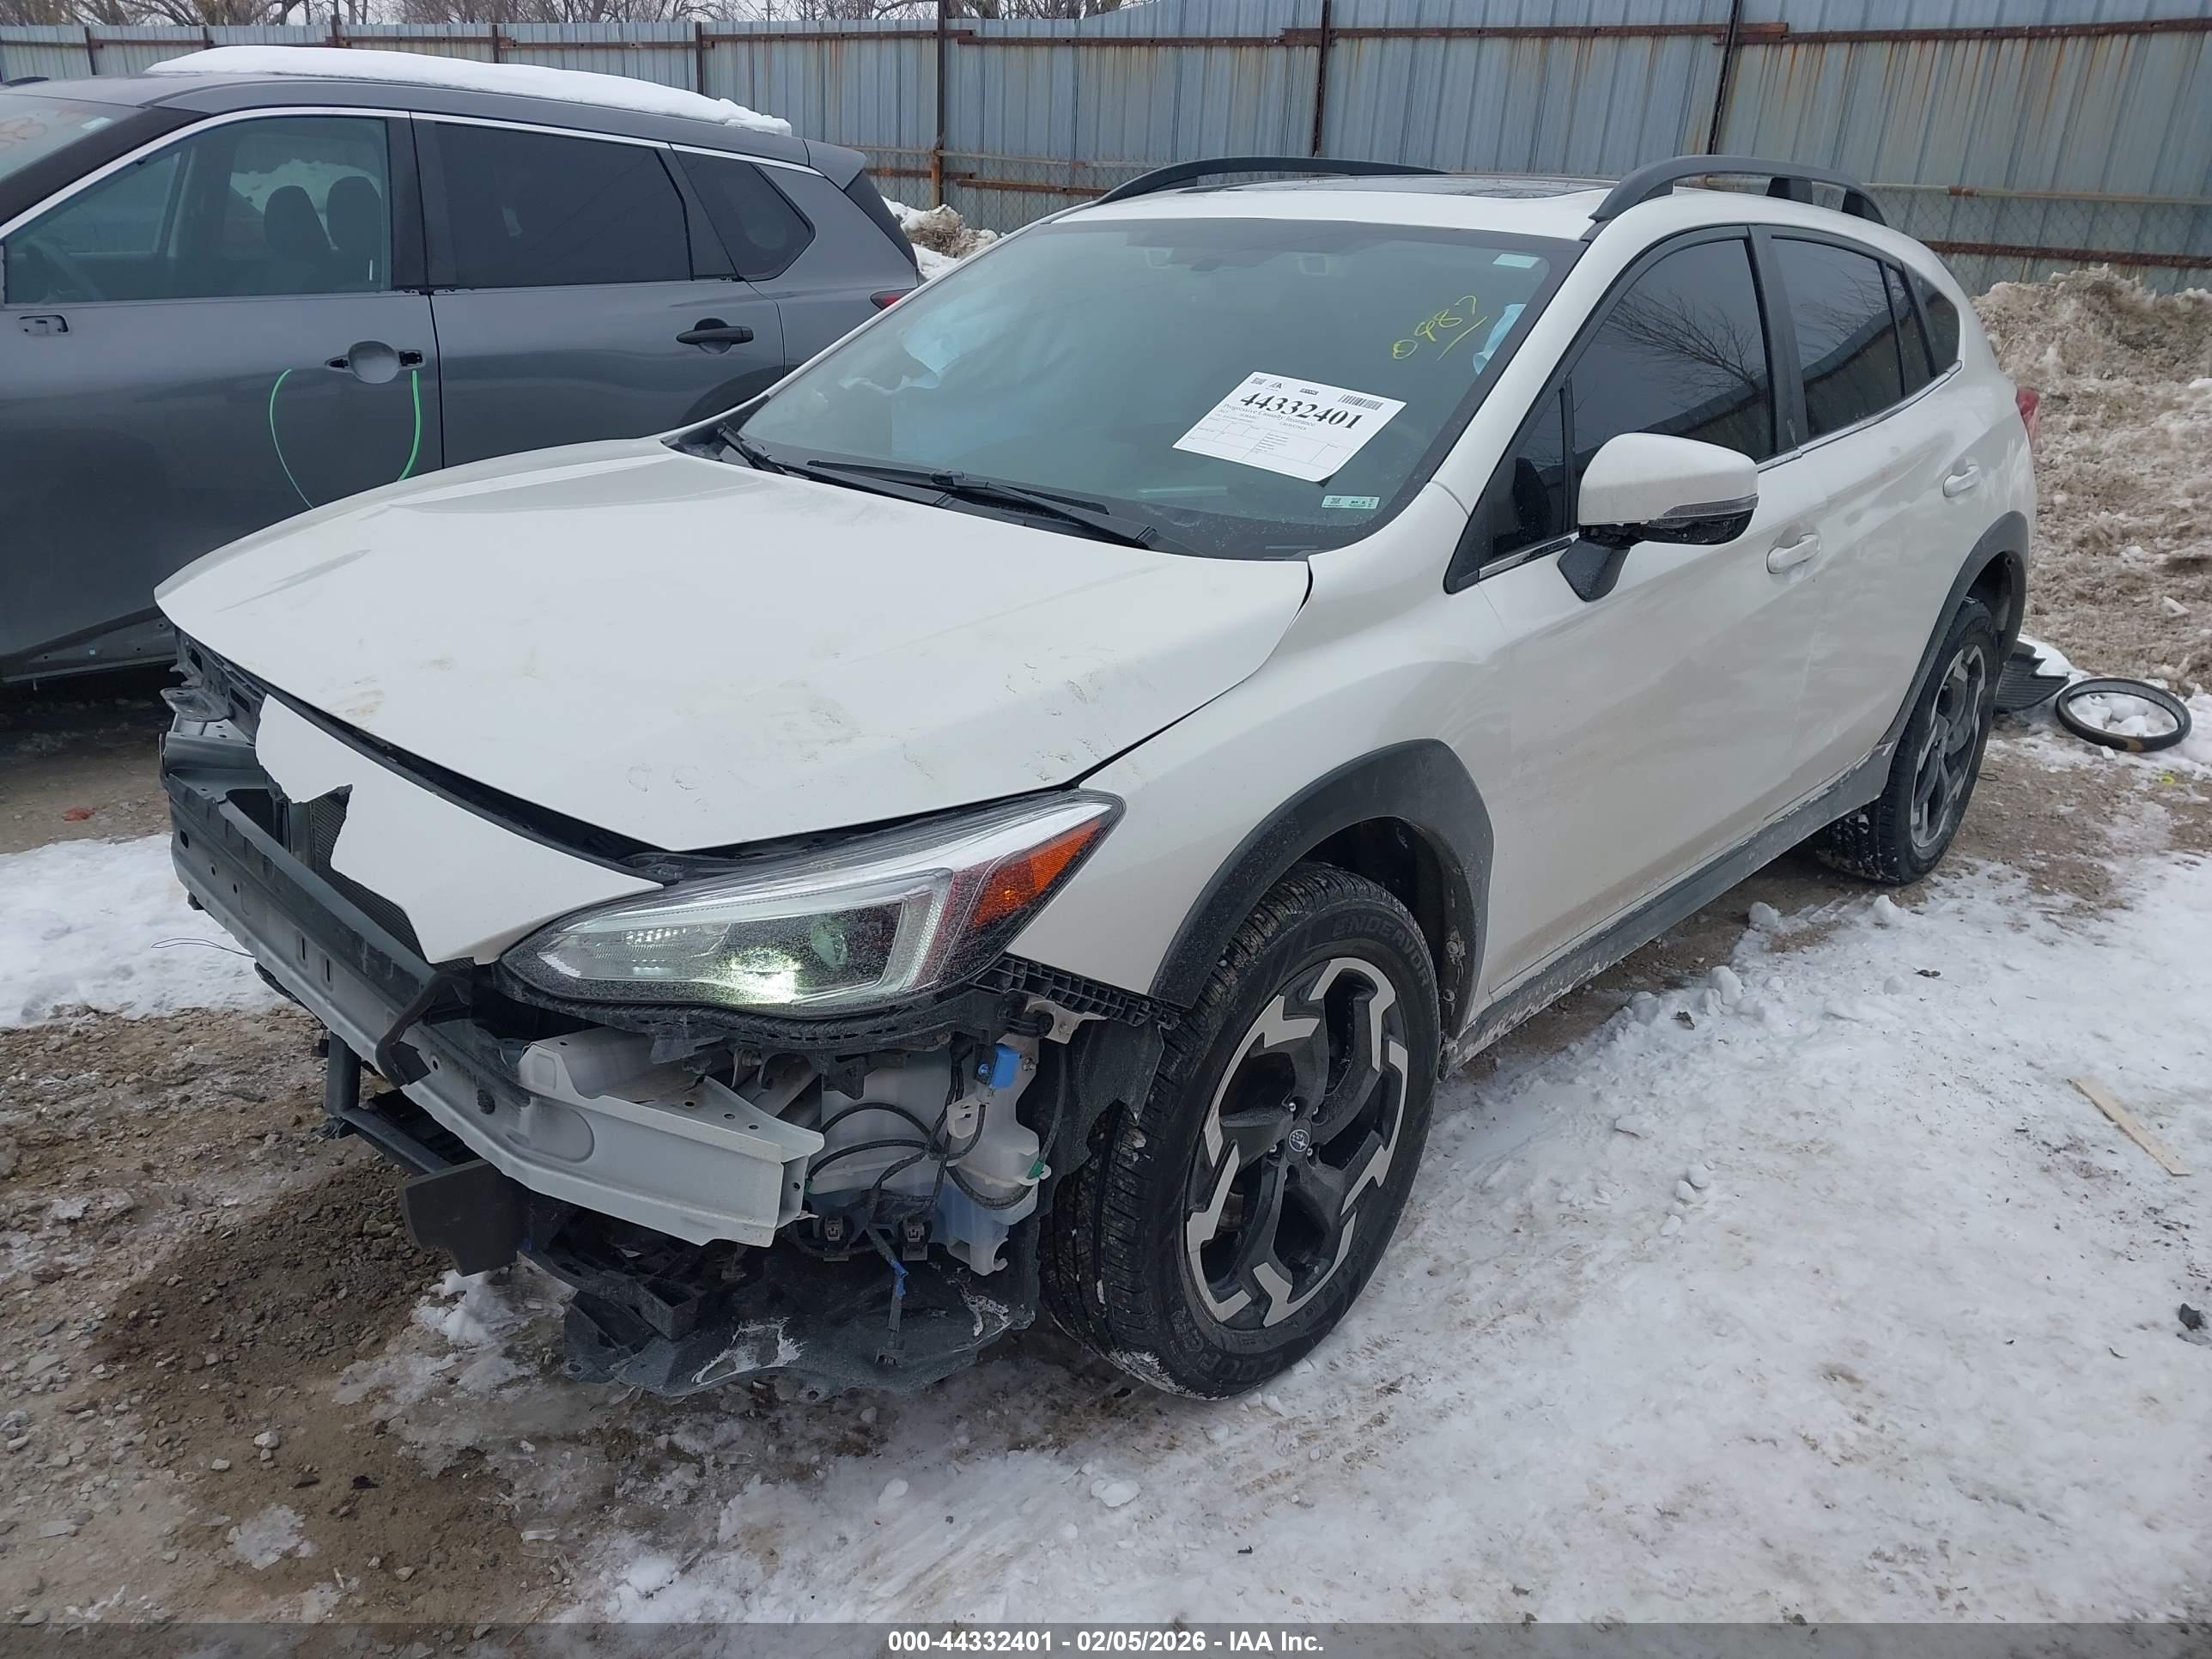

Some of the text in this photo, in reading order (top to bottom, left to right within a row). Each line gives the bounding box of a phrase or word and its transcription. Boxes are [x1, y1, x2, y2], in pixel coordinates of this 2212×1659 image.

[1223, 403, 1256, 415] Progressive
[1259, 409, 1285, 421] Casualty
[1287, 416, 1316, 427] Insurance
[1240, 392, 1364, 429] 44332401
[1332, 915, 1431, 989] ENDEAVOR
